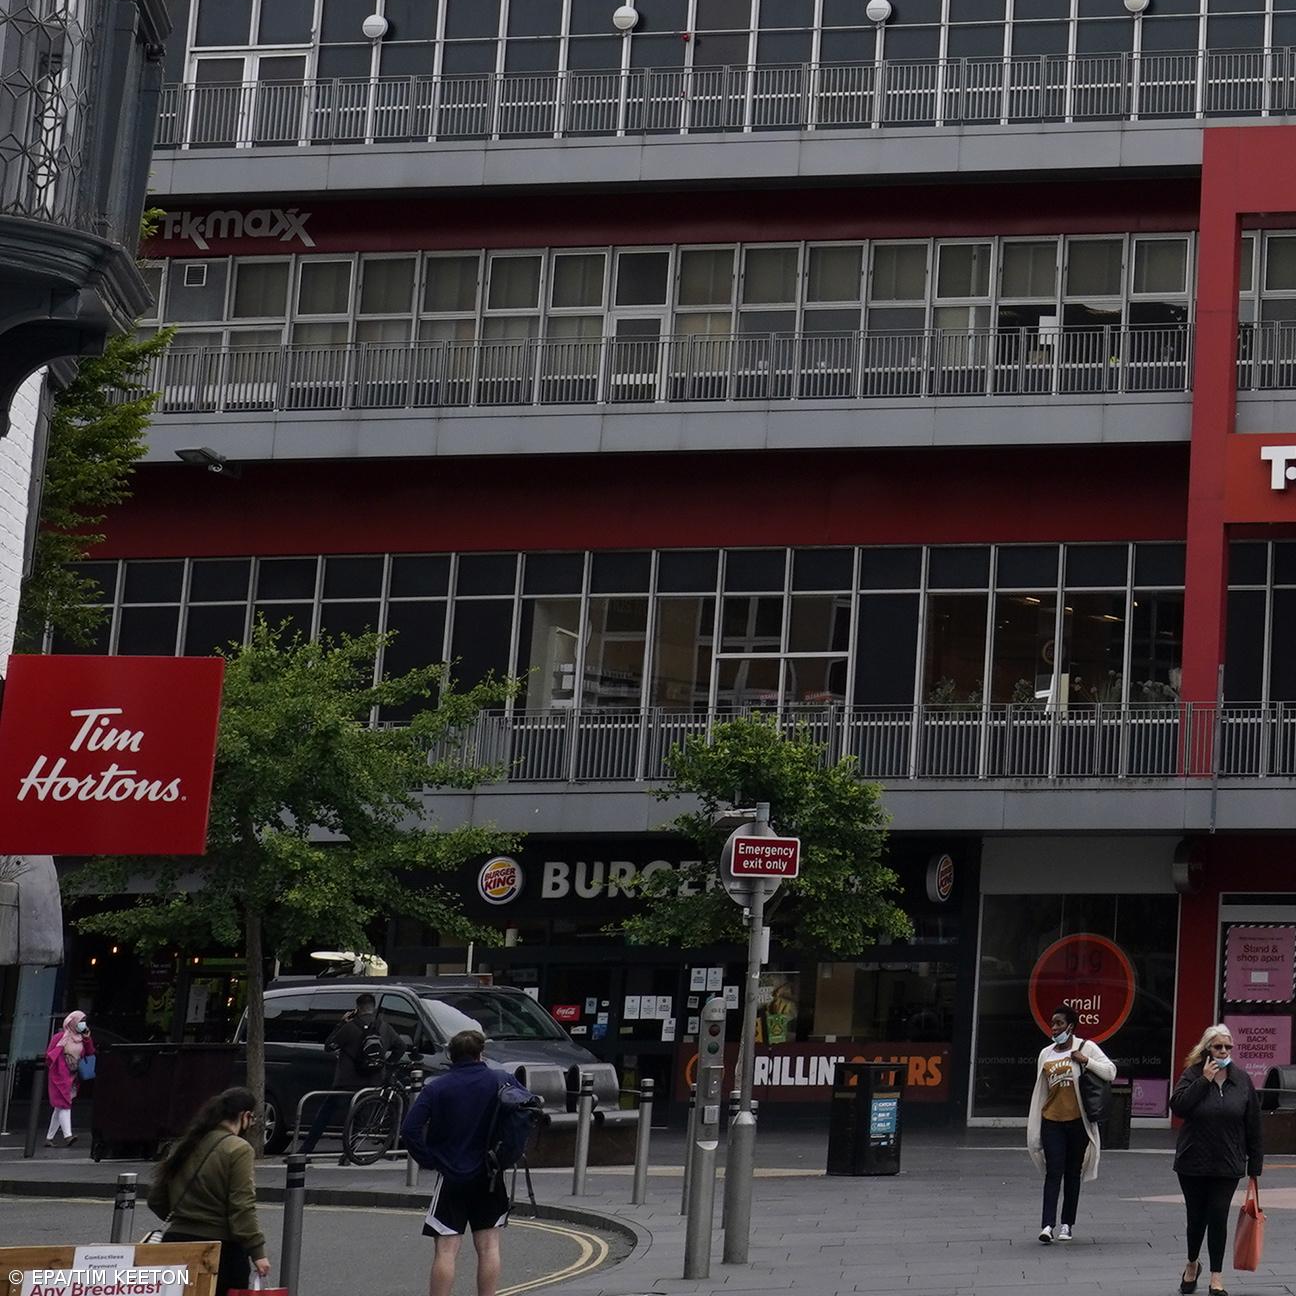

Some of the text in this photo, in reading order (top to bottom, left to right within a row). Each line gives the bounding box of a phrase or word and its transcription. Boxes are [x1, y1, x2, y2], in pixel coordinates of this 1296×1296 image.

[69, 707, 145, 752] Tim
[17, 755, 181, 802] Hortons
[738, 842, 795, 858] Emergency
[743, 858, 788, 872] exit only
[484, 867, 516, 881] BURGER
[484, 875, 516, 892] KING
[1243, 944, 1278, 953] Stand &
[1237, 953, 1285, 963] shop apart
[1063, 995, 1101, 1010] small
[1238, 1027, 1276, 1035] WELCOME
[1246, 1035, 1268, 1043] BACK
[1237, 1043, 1277, 1051] TREASURE
[1239, 1051, 1274, 1059] SEEKERS
[71, 1279, 162, 1296] Breakfast
